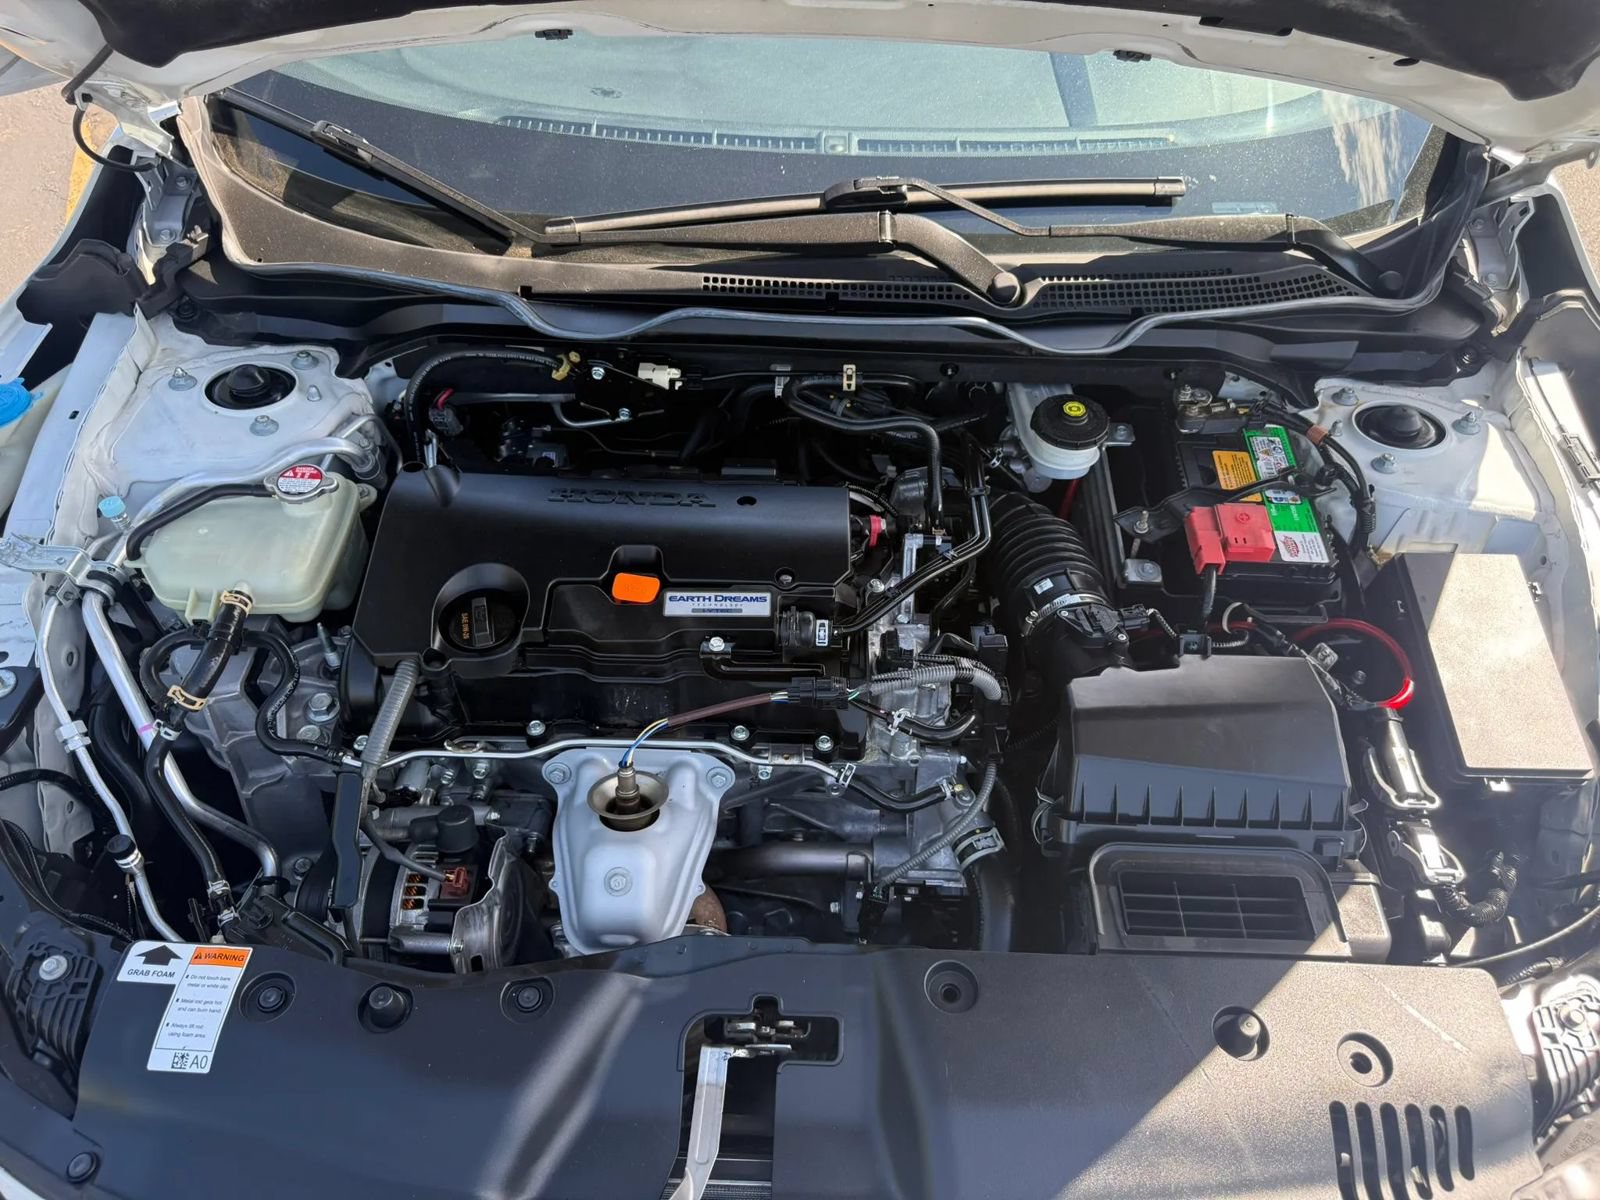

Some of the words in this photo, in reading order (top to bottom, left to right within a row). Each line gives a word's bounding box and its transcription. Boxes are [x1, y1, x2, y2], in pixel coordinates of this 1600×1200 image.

[548, 488, 717, 508] HONDA
[668, 595, 712, 603] EARTH
[714, 594, 768, 603] DREAMS
[204, 952, 246, 963] WARNING
[127, 968, 151, 977] GRAB
[152, 970, 176, 979] FOAM
[170, 1022, 188, 1030] Always
[189, 1055, 209, 1070] A0
